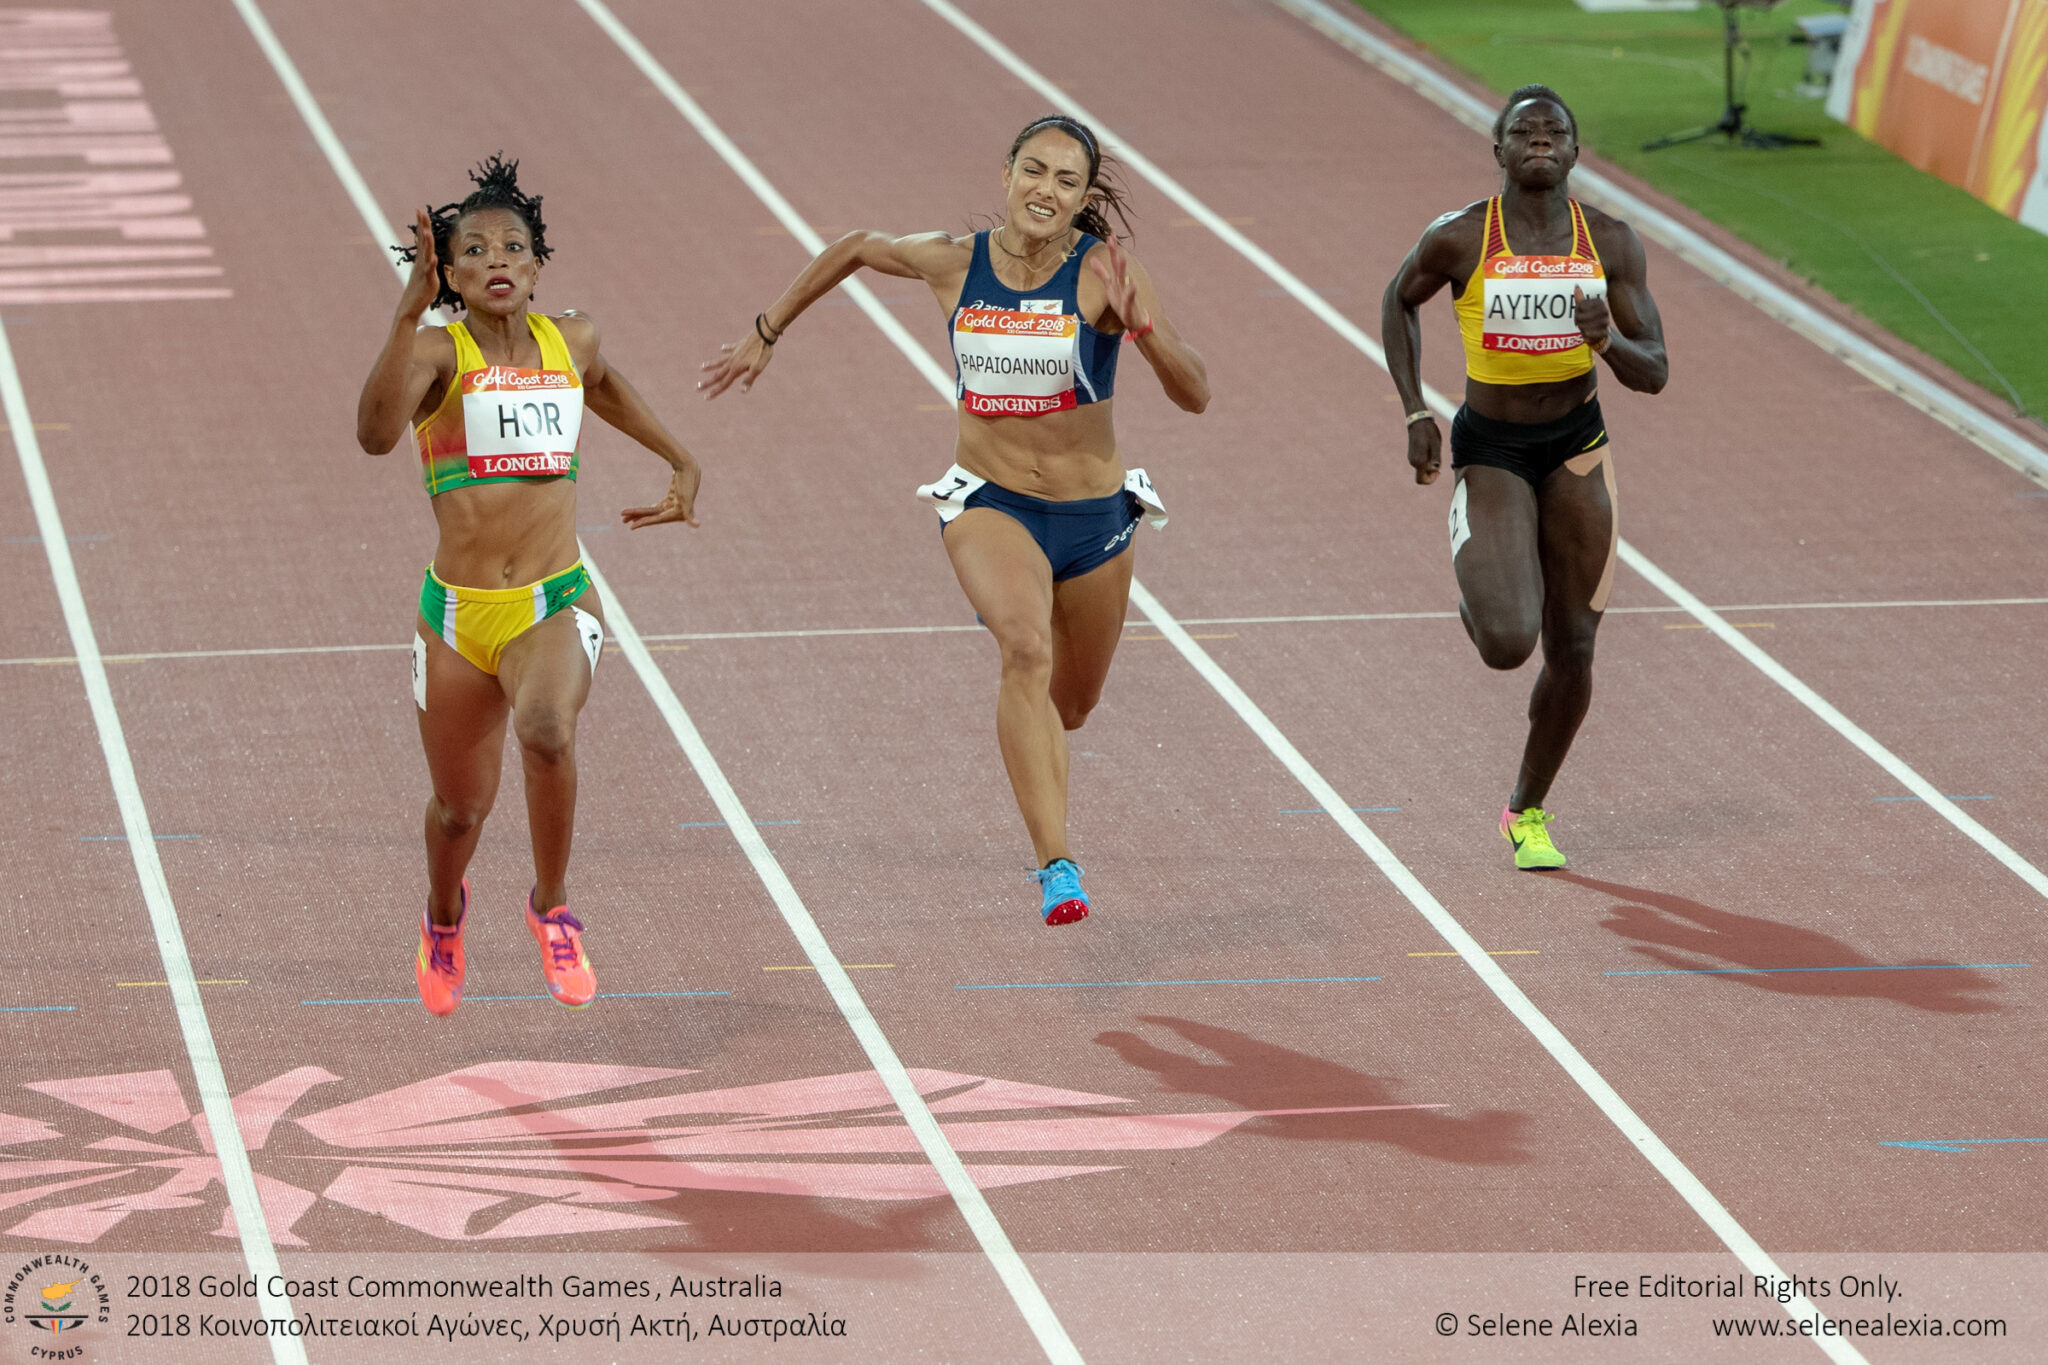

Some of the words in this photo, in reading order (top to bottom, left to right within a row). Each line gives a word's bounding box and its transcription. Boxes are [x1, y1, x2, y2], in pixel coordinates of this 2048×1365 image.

[1495, 261, 1528, 274] Gold
[1531, 261, 1565, 273] Coast
[1568, 262, 1593, 273] 2018
[1489, 294, 1600, 319] AYIKO
[964, 313, 995, 328] Gold
[999, 315, 1034, 330] Coast
[1037, 319, 1065, 331] 2018
[1496, 335, 1584, 351] LONGINES
[961, 353, 1069, 376] PAPAIOANNOU
[473, 368, 506, 386] Gold
[508, 371, 541, 386] Coast
[543, 374, 569, 385] 2018
[972, 395, 1061, 412] LONGINES
[498, 402, 563, 438] HOR
